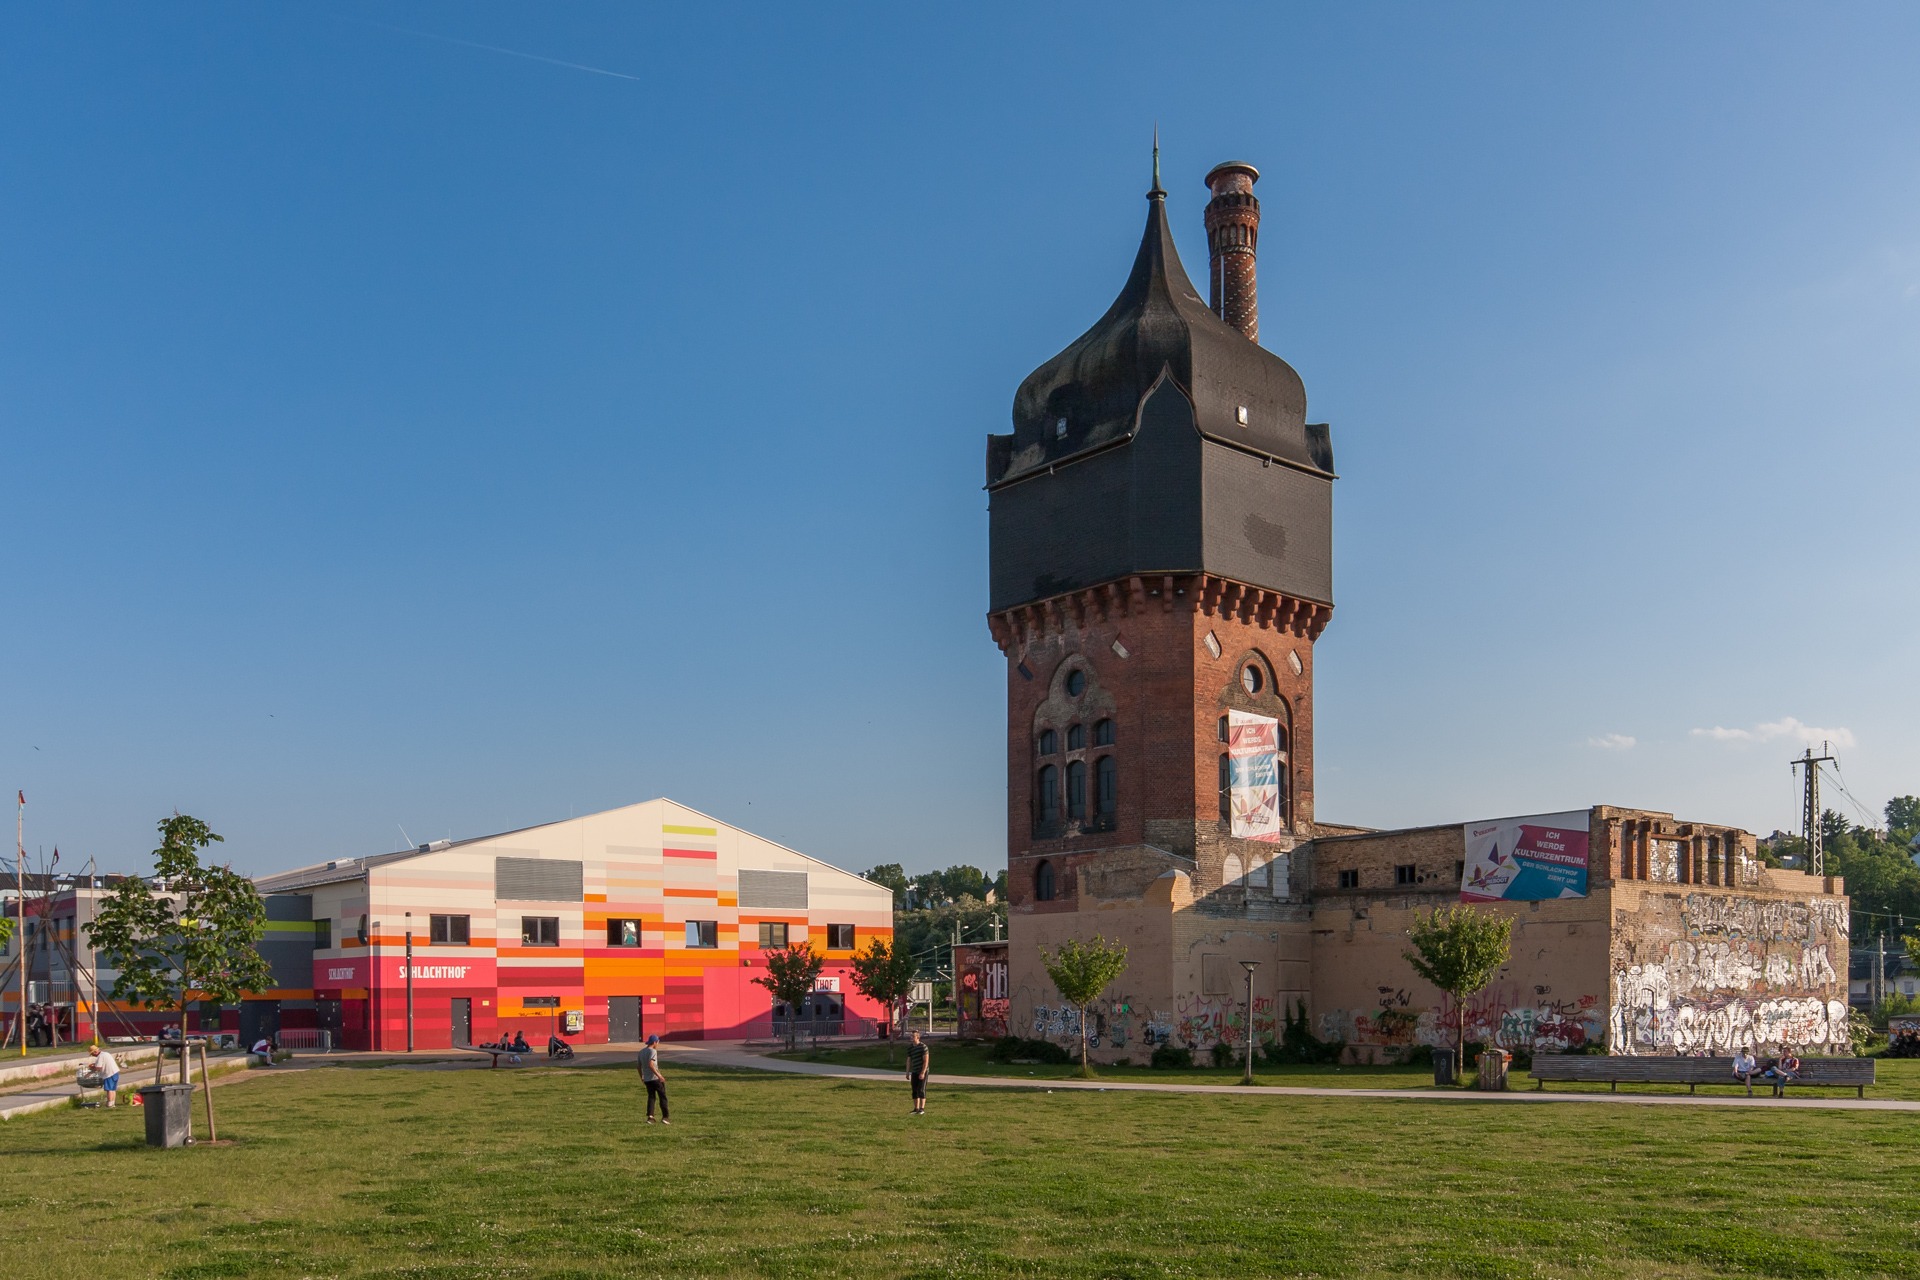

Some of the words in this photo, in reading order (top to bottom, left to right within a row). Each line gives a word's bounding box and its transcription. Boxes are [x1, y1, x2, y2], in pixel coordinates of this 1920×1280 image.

[1545, 831, 1560, 840] ICH
[1536, 840, 1565, 851] WERDE
[1514, 847, 1586, 866] KULTURZENTRUM.
[1522, 861, 1535, 869] DER
[1535, 864, 1578, 877] SCHLACHTHOF
[1547, 874, 1565, 883] ZIEHT
